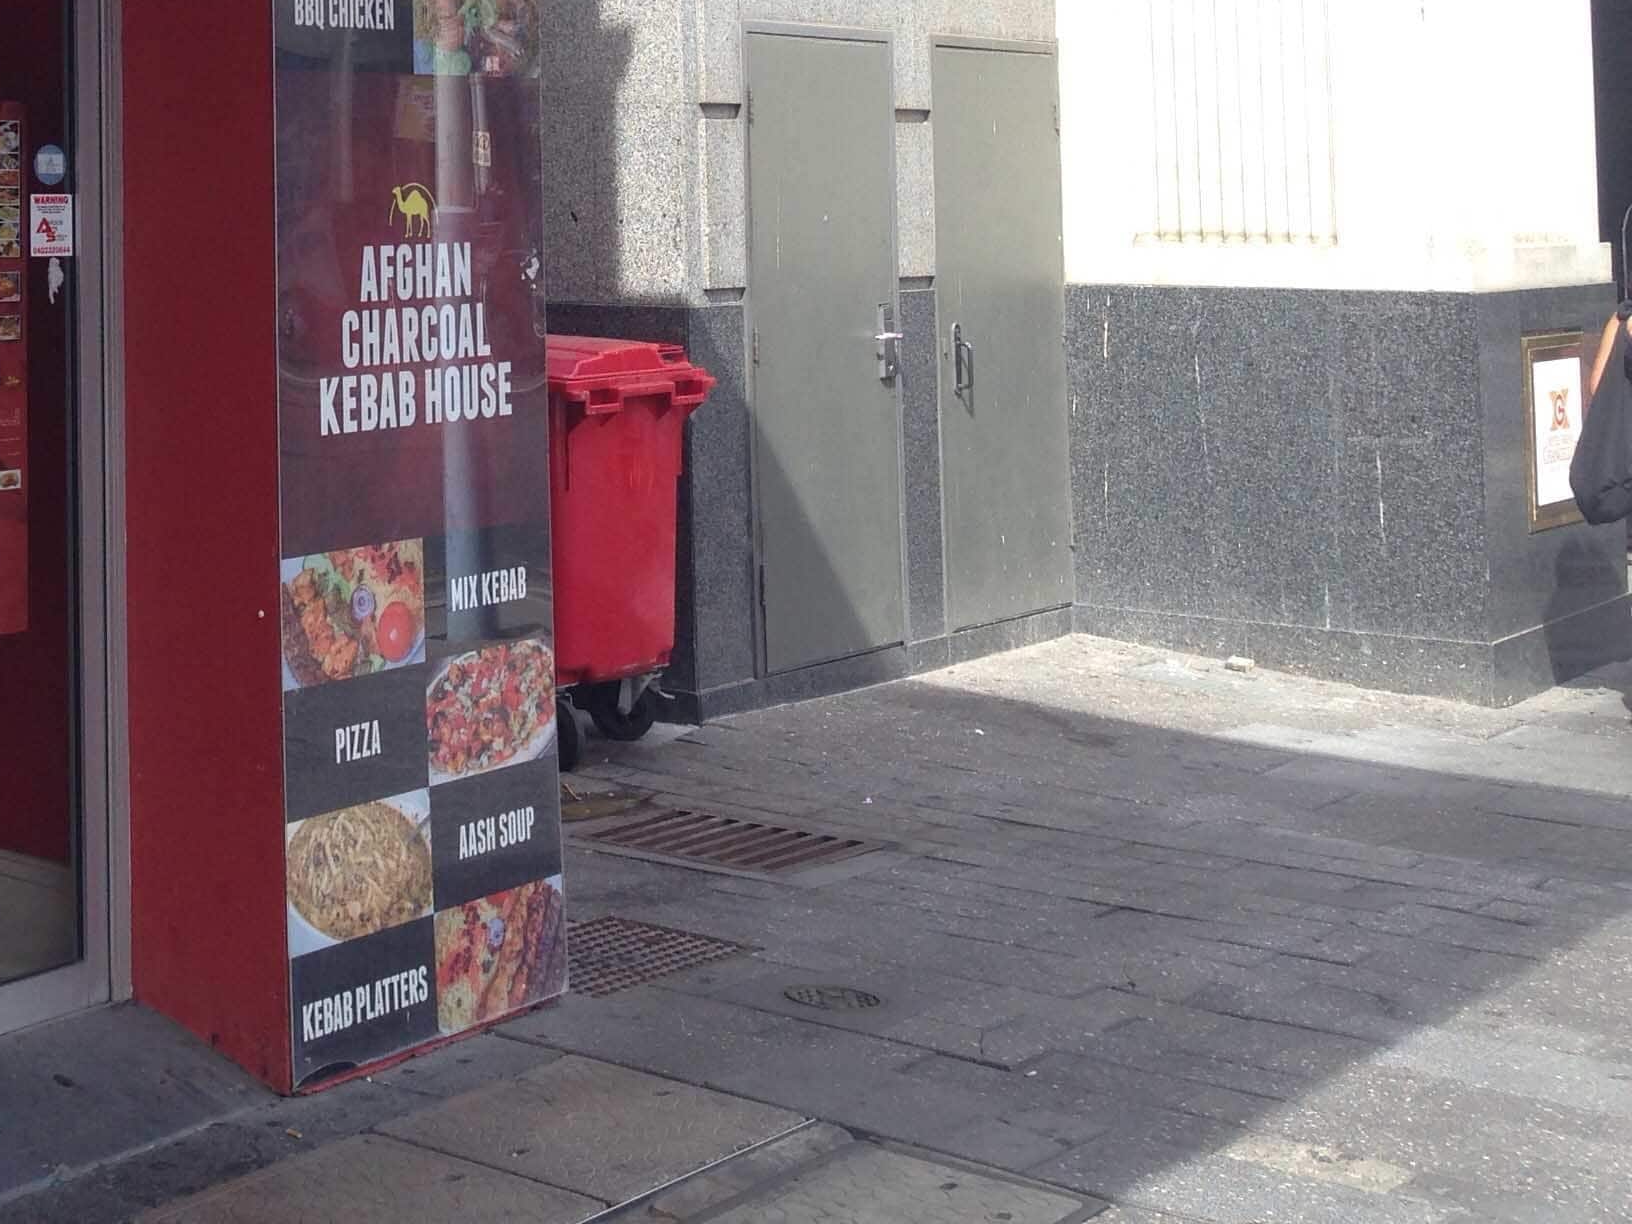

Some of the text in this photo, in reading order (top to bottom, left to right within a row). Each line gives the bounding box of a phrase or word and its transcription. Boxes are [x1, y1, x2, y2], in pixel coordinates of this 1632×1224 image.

[360, 242, 471, 302] AFGHAN
[342, 302, 491, 369] CHARCOAL
[319, 361, 513, 436] KEBAB HOUSE
[451, 566, 526, 611] MIX KEBAB
[335, 720, 381, 764] PIZZA
[459, 806, 535, 860] AASH SOUP
[303, 966, 429, 1042] KEBAB PLATTERS
